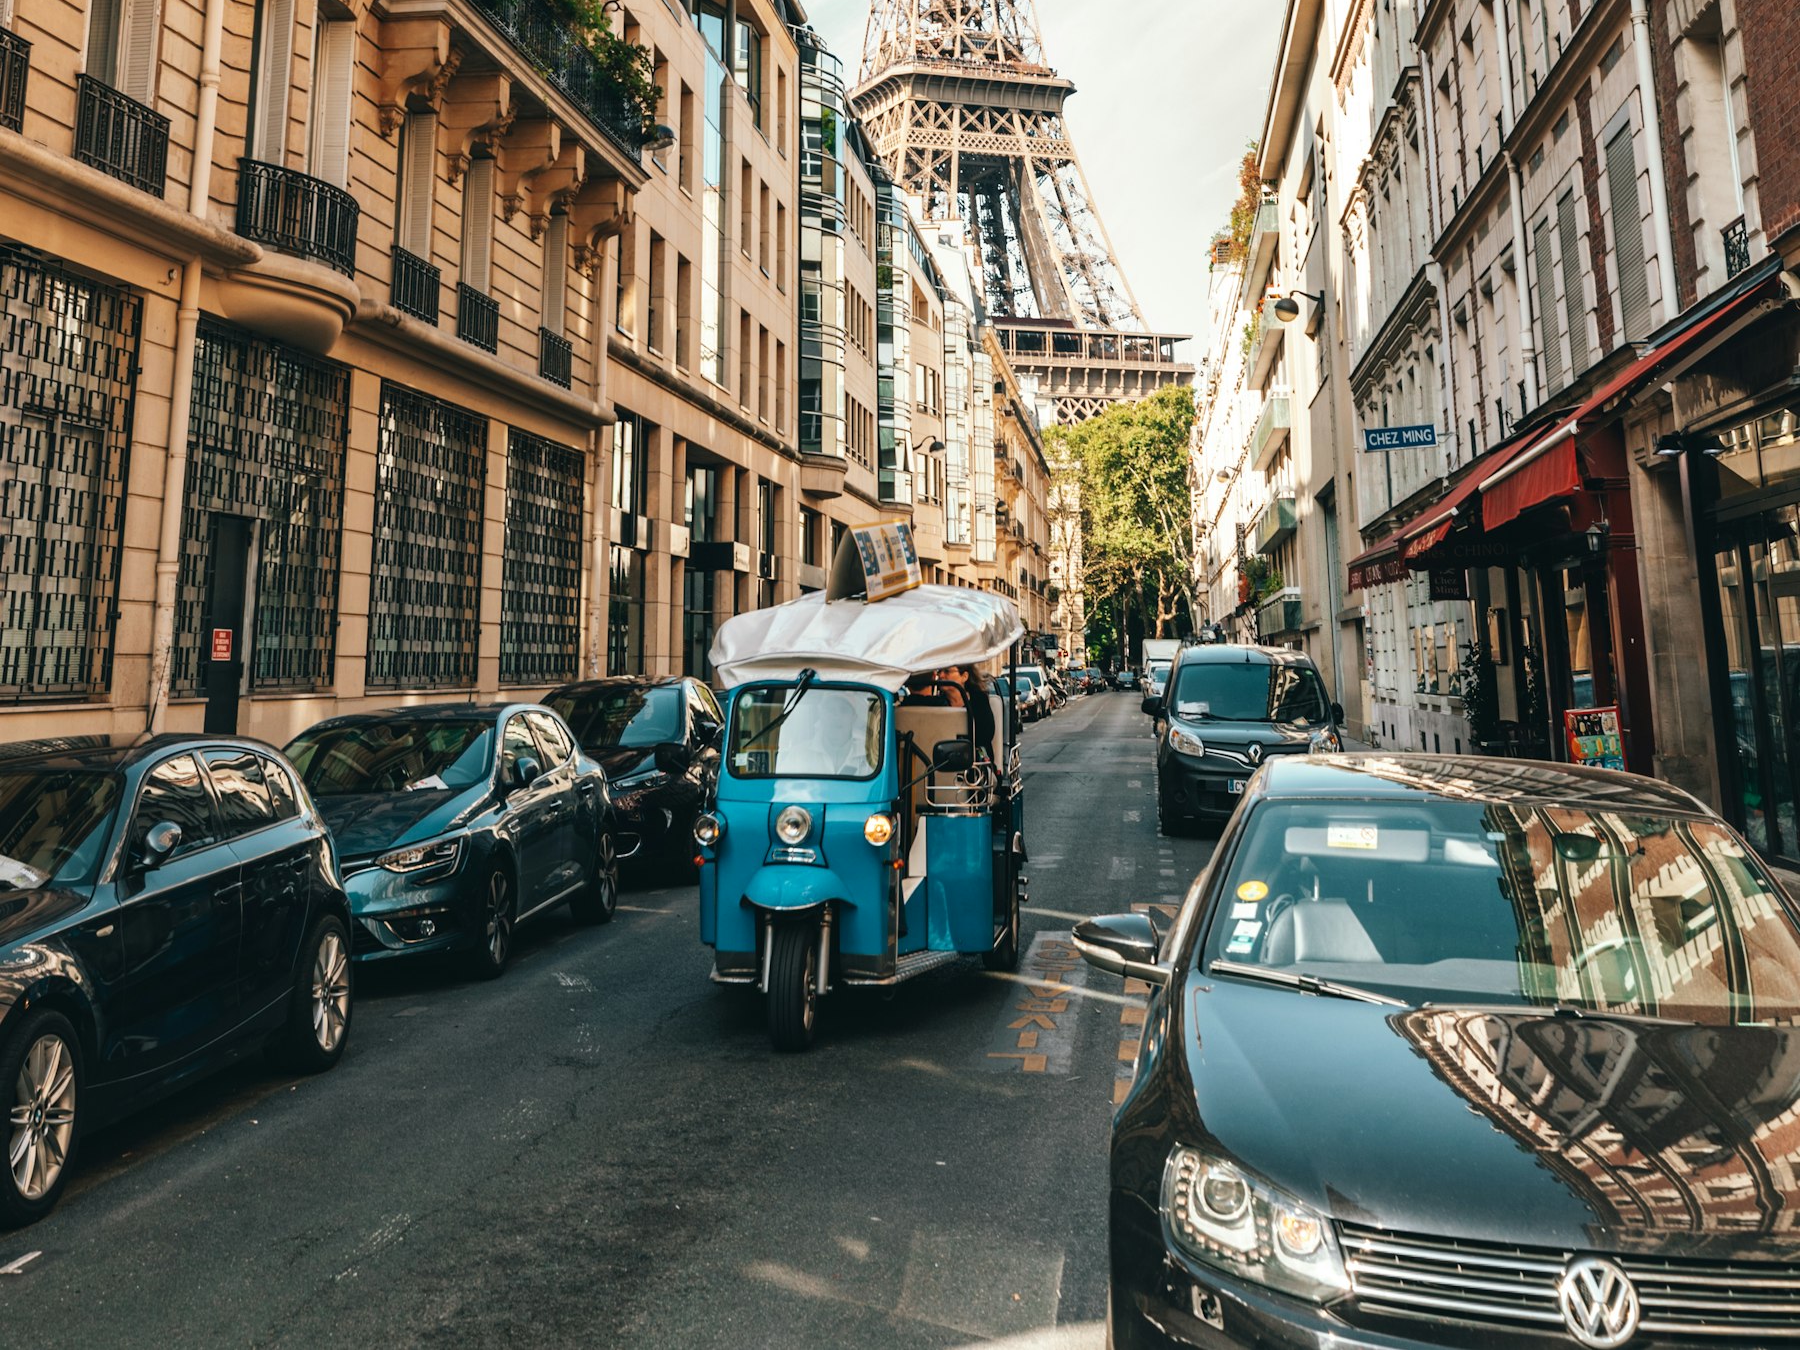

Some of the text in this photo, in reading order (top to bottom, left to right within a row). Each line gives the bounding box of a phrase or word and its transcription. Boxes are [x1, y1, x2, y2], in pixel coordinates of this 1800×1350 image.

[1368, 429, 1432, 446] CHEZ MING
[1434, 576, 1457, 585] Chez
[1435, 585, 1460, 595] Ming
